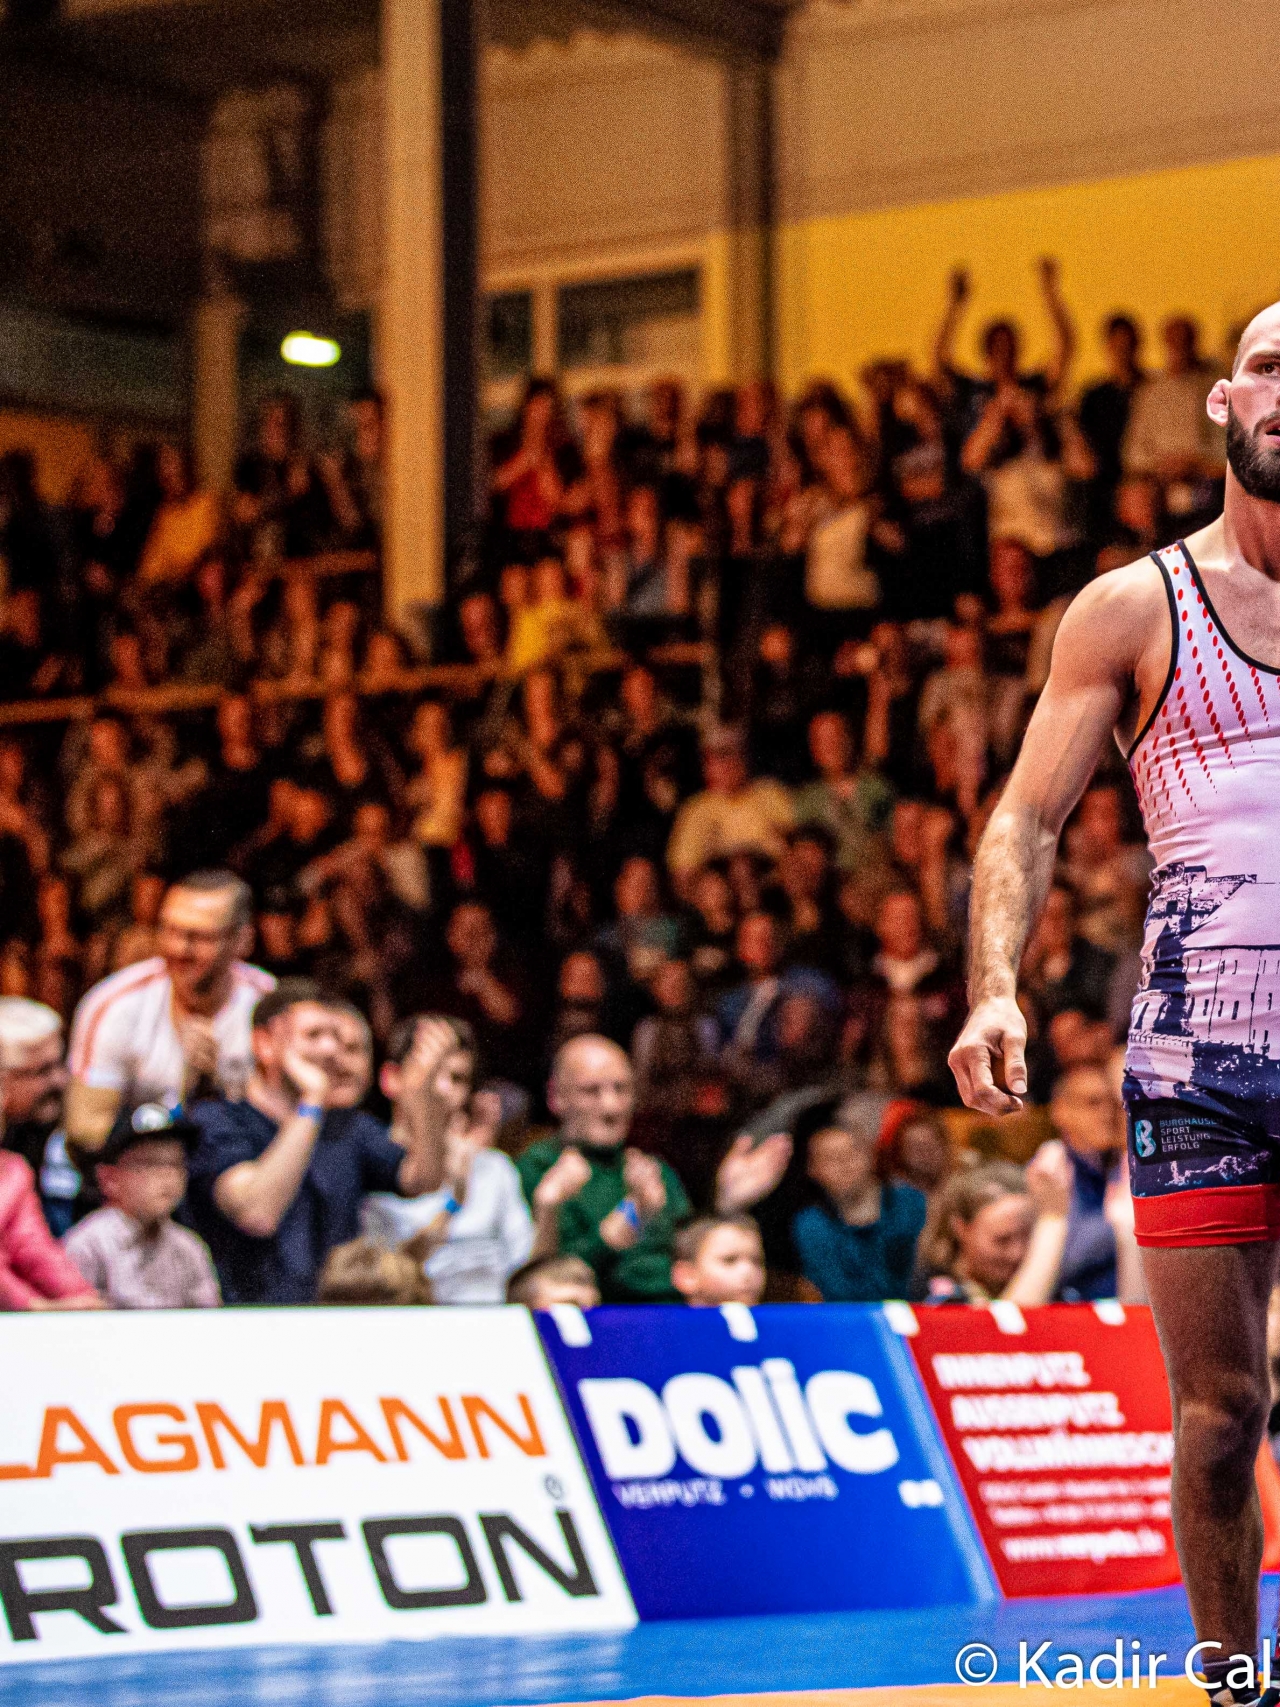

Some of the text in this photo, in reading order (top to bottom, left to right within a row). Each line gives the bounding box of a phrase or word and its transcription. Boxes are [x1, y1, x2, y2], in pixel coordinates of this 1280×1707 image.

[1160, 1126, 1191, 1135] SPORT
[1161, 1133, 1211, 1145] LEISTUNG
[1162, 1142, 1200, 1153] ERFOLG
[0, 1508, 600, 1642] ROTON
